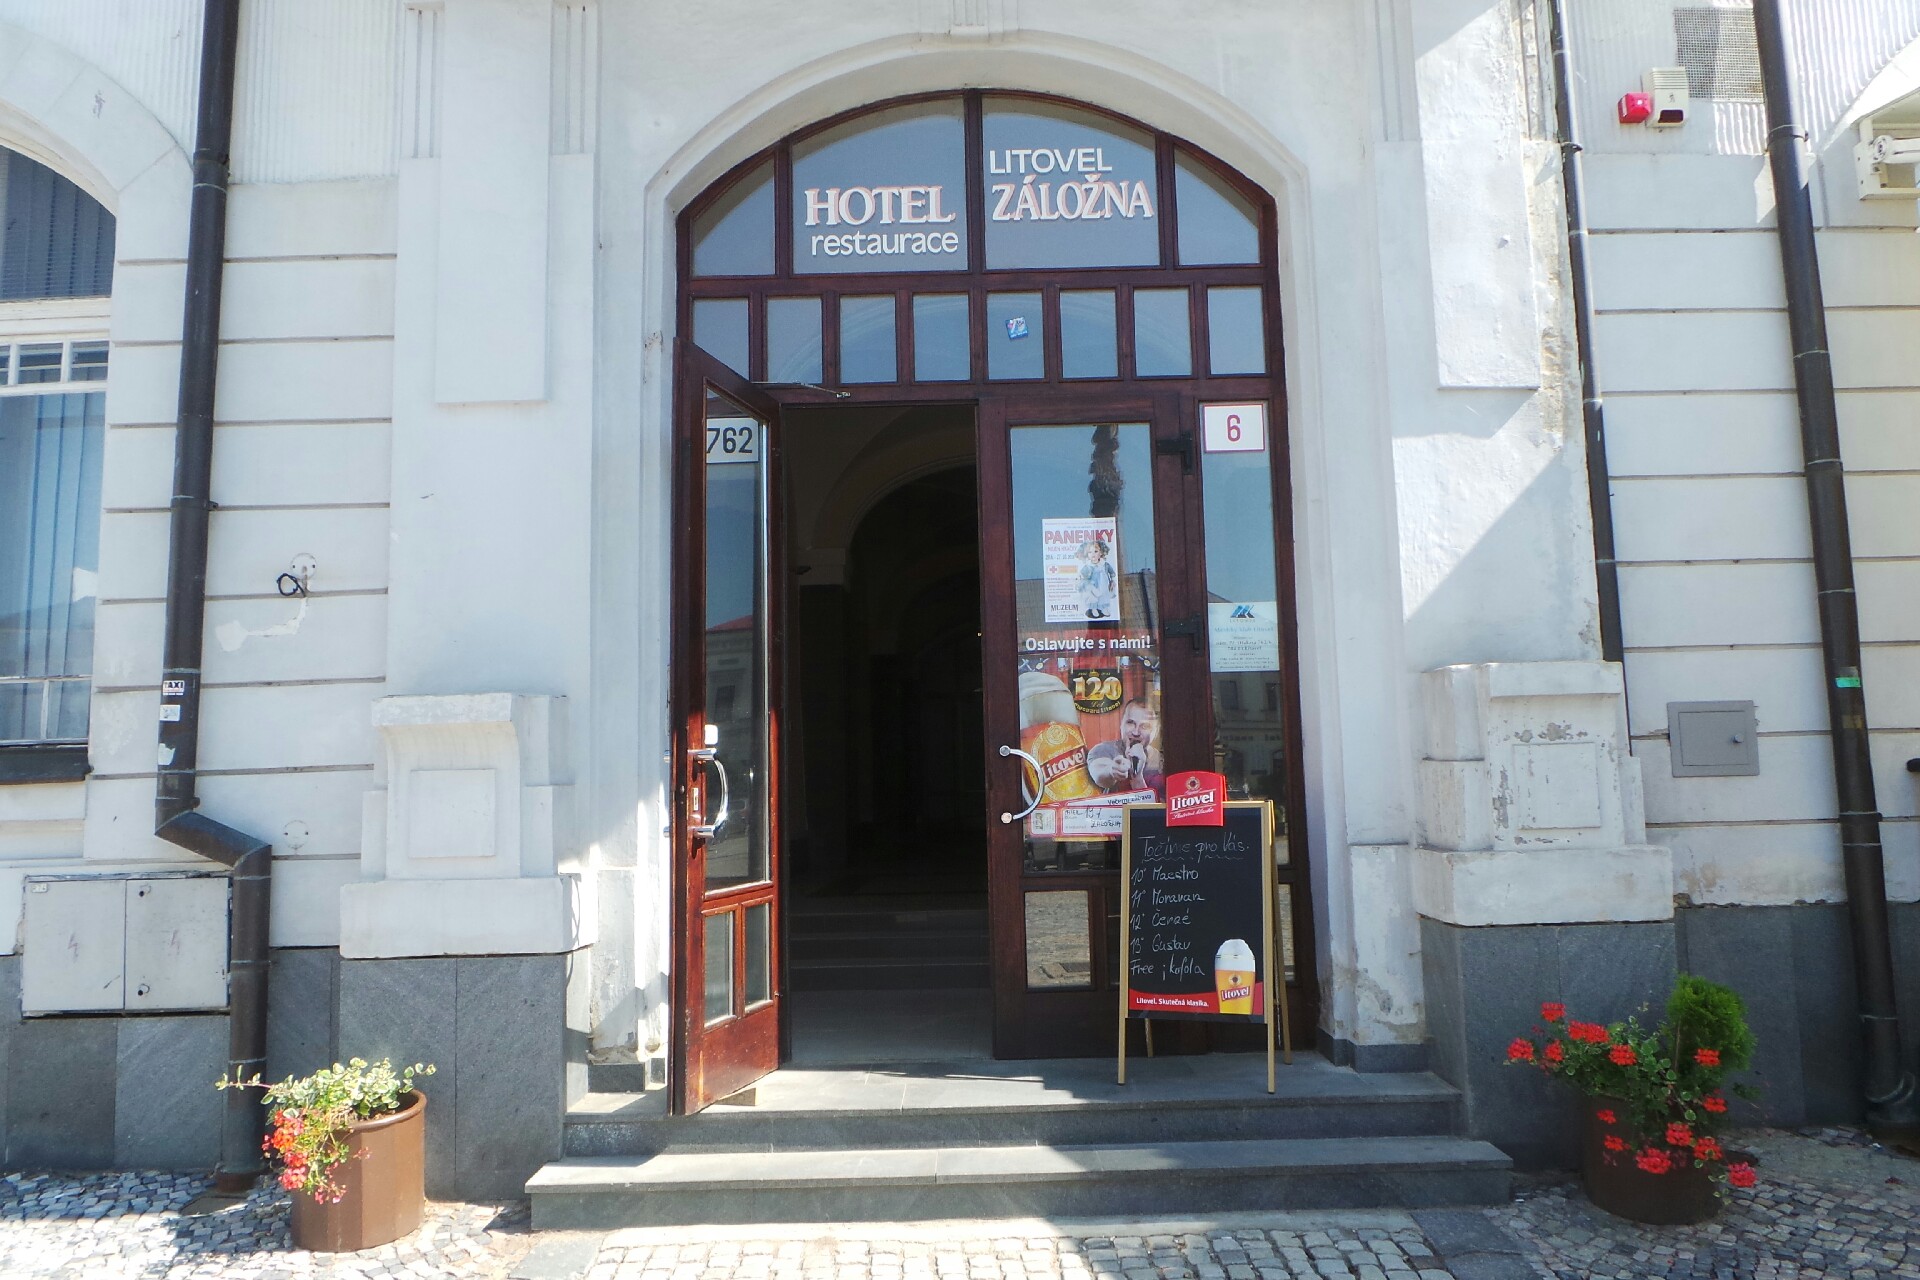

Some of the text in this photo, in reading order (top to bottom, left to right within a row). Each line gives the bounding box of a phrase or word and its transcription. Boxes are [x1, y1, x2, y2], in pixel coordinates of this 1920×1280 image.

[989, 148, 1112, 174] LITOVEL
[804, 186, 957, 226] HOTEL
[991, 174, 1155, 221] ZÁLOŽNA
[811, 231, 958, 256] restaurace
[1227, 414, 1241, 442] 6
[707, 427, 753, 453] 762
[1045, 529, 1115, 544] PANENKY
[1025, 635, 1151, 652] Oslavujte s námi!
[163, 681, 184, 689] TAXI
[1072, 676, 1122, 700] 120
[1171, 791, 1214, 811] Litovel
[1195, 842, 1218, 863] pro
[1152, 865, 1199, 880] Maestro
[1152, 888, 1205, 905] Moravan
[1152, 934, 1191, 952] Gustav
[1130, 959, 1155, 976] Free
[1136, 997, 1158, 1005] Litovel.
[1158, 998, 1186, 1006] Skutečná
[1221, 987, 1250, 1001] Litovel
